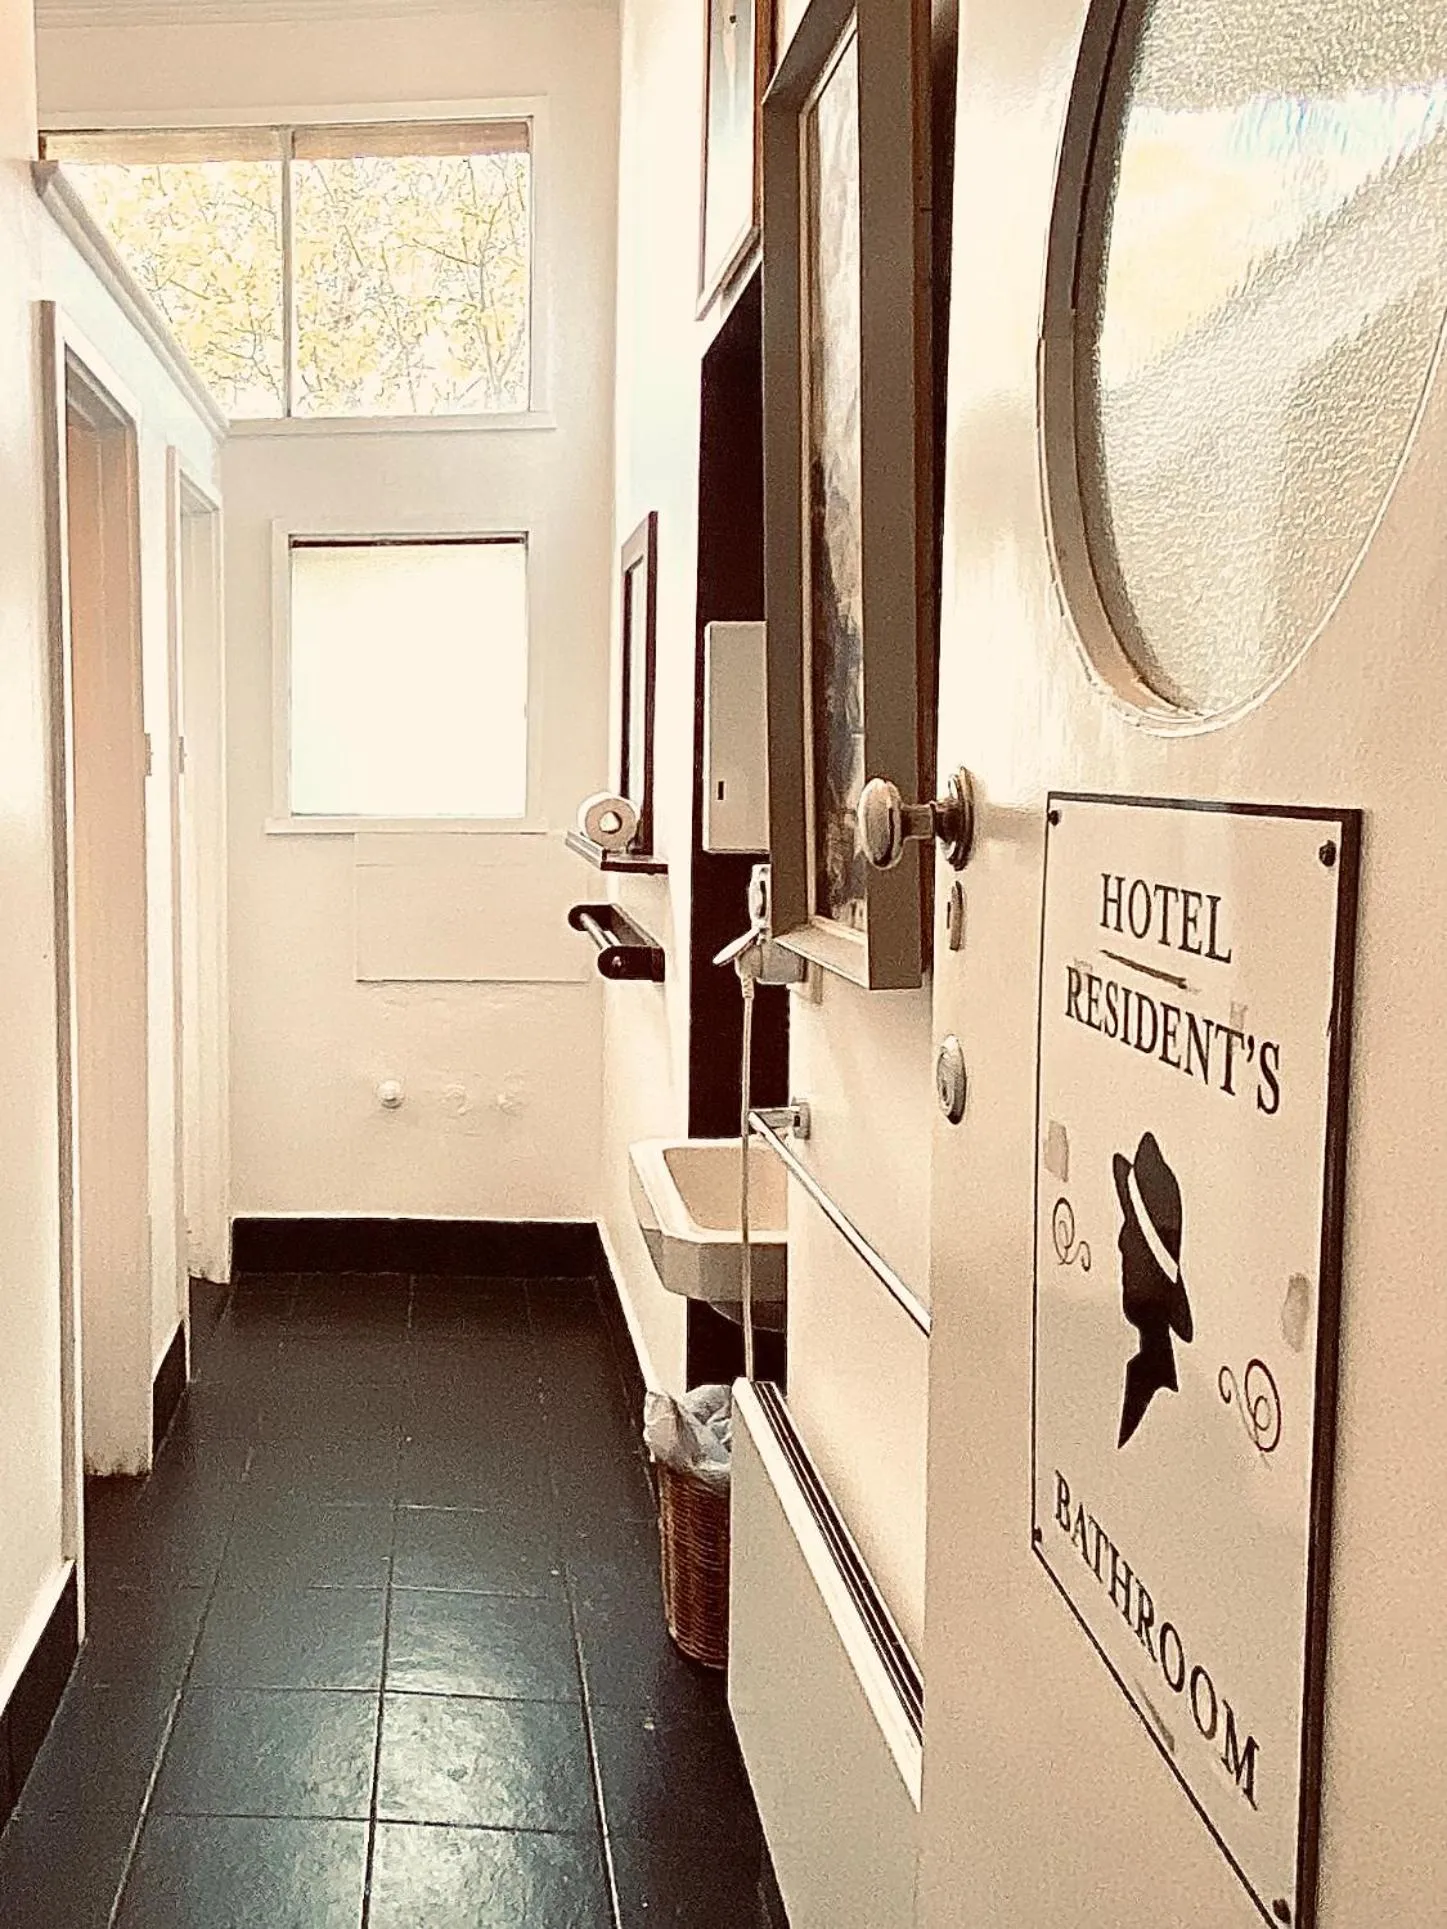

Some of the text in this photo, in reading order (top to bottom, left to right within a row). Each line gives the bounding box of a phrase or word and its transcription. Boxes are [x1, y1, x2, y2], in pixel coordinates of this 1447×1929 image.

[1100, 873, 1231, 964] HOTEL
[1065, 965, 1280, 1115] RESIDENT'S
[1055, 1468, 1259, 1812] BATHROOM
